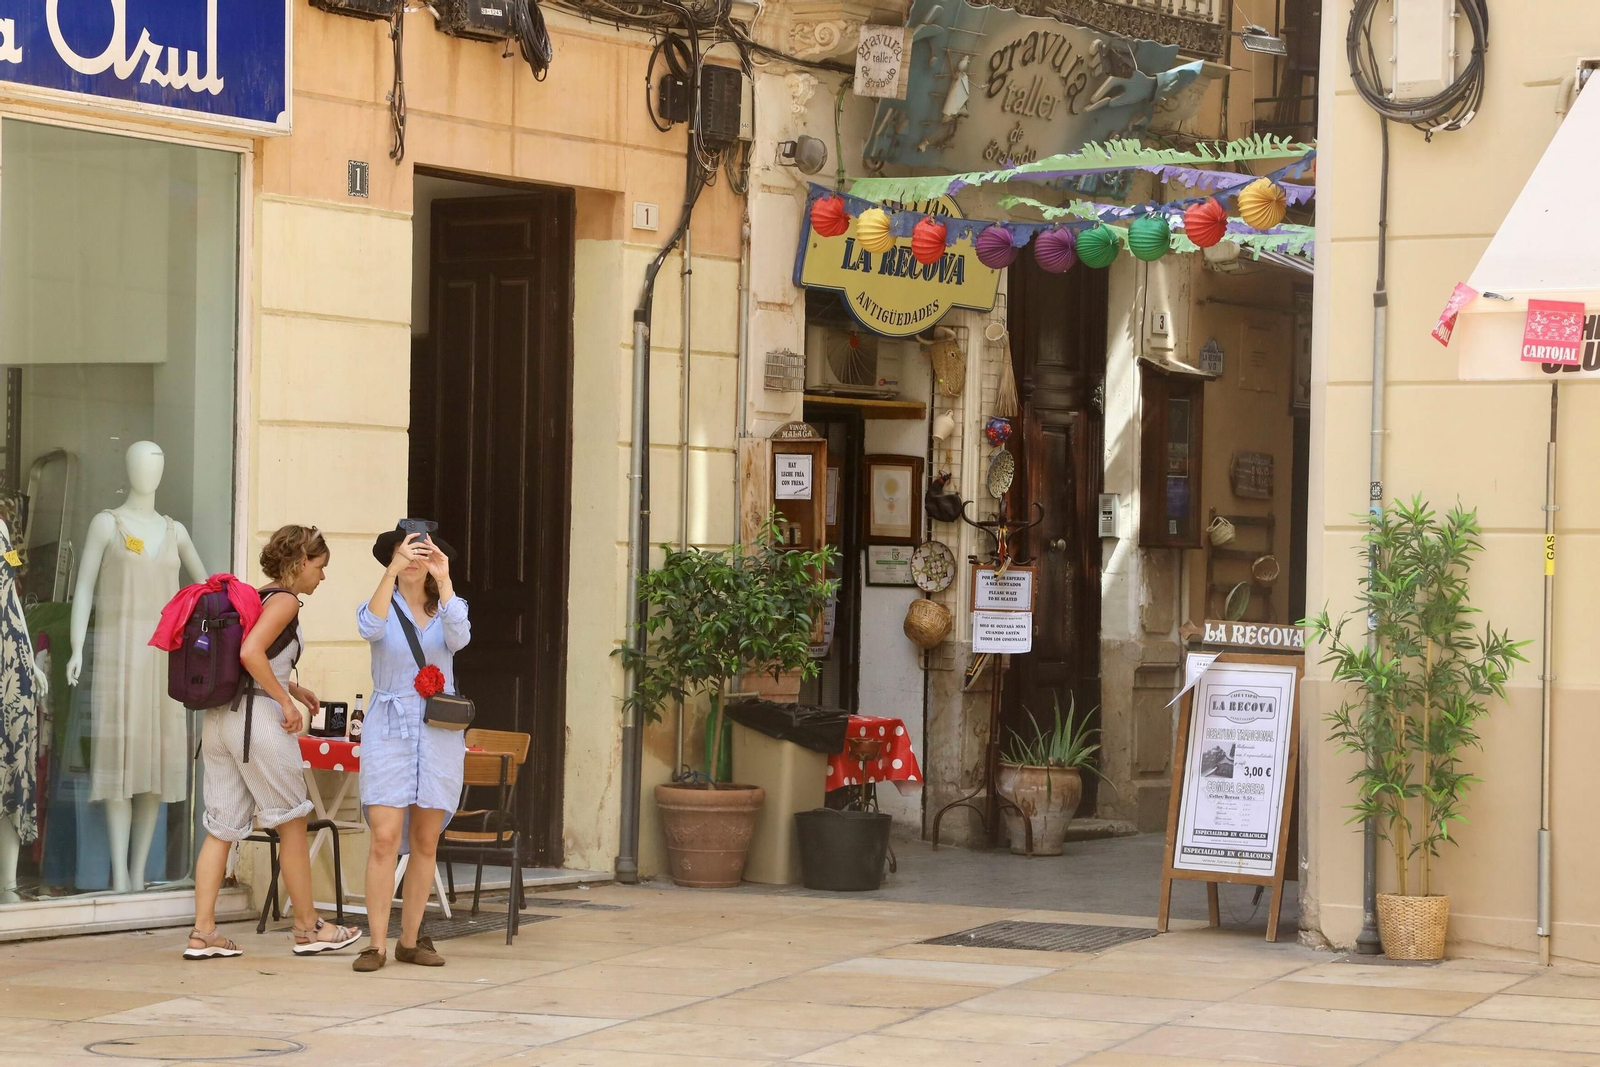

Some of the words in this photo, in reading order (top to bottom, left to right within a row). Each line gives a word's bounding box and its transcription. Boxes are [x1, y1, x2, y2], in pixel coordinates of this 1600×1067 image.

[858, 34, 902, 62] gravura
[872, 52, 892, 63] taller
[862, 66, 870, 78] de
[865, 68, 896, 88] grabado
[987, 30, 1087, 115] gravura
[1001, 74, 1061, 121] taller
[1007, 120, 1024, 144] de
[355, 168, 361, 191] 1
[645, 208, 650, 226] 1
[841, 238, 872, 272] LA
[856, 290, 940, 326] ANTIGÜEDADES
[1160, 315, 1164, 330] 3
[1523, 344, 1577, 361] CARTOJAL
[1203, 623, 1227, 642] LA
[1212, 701, 1225, 710] LA
[1229, 702, 1273, 712] RECOVA
[1206, 728, 1236, 740] DESAYUNO
[1237, 729, 1274, 742] TRADICIONAL
[1244, 766, 1263, 778] 3,00
[1266, 767, 1271, 777] €
[1206, 781, 1235, 793] COMIDA
[1236, 782, 1265, 794] CASERA
[1184, 847, 1224, 856] ESPECIALIDAD
[1238, 852, 1271, 860] CARACOLES
